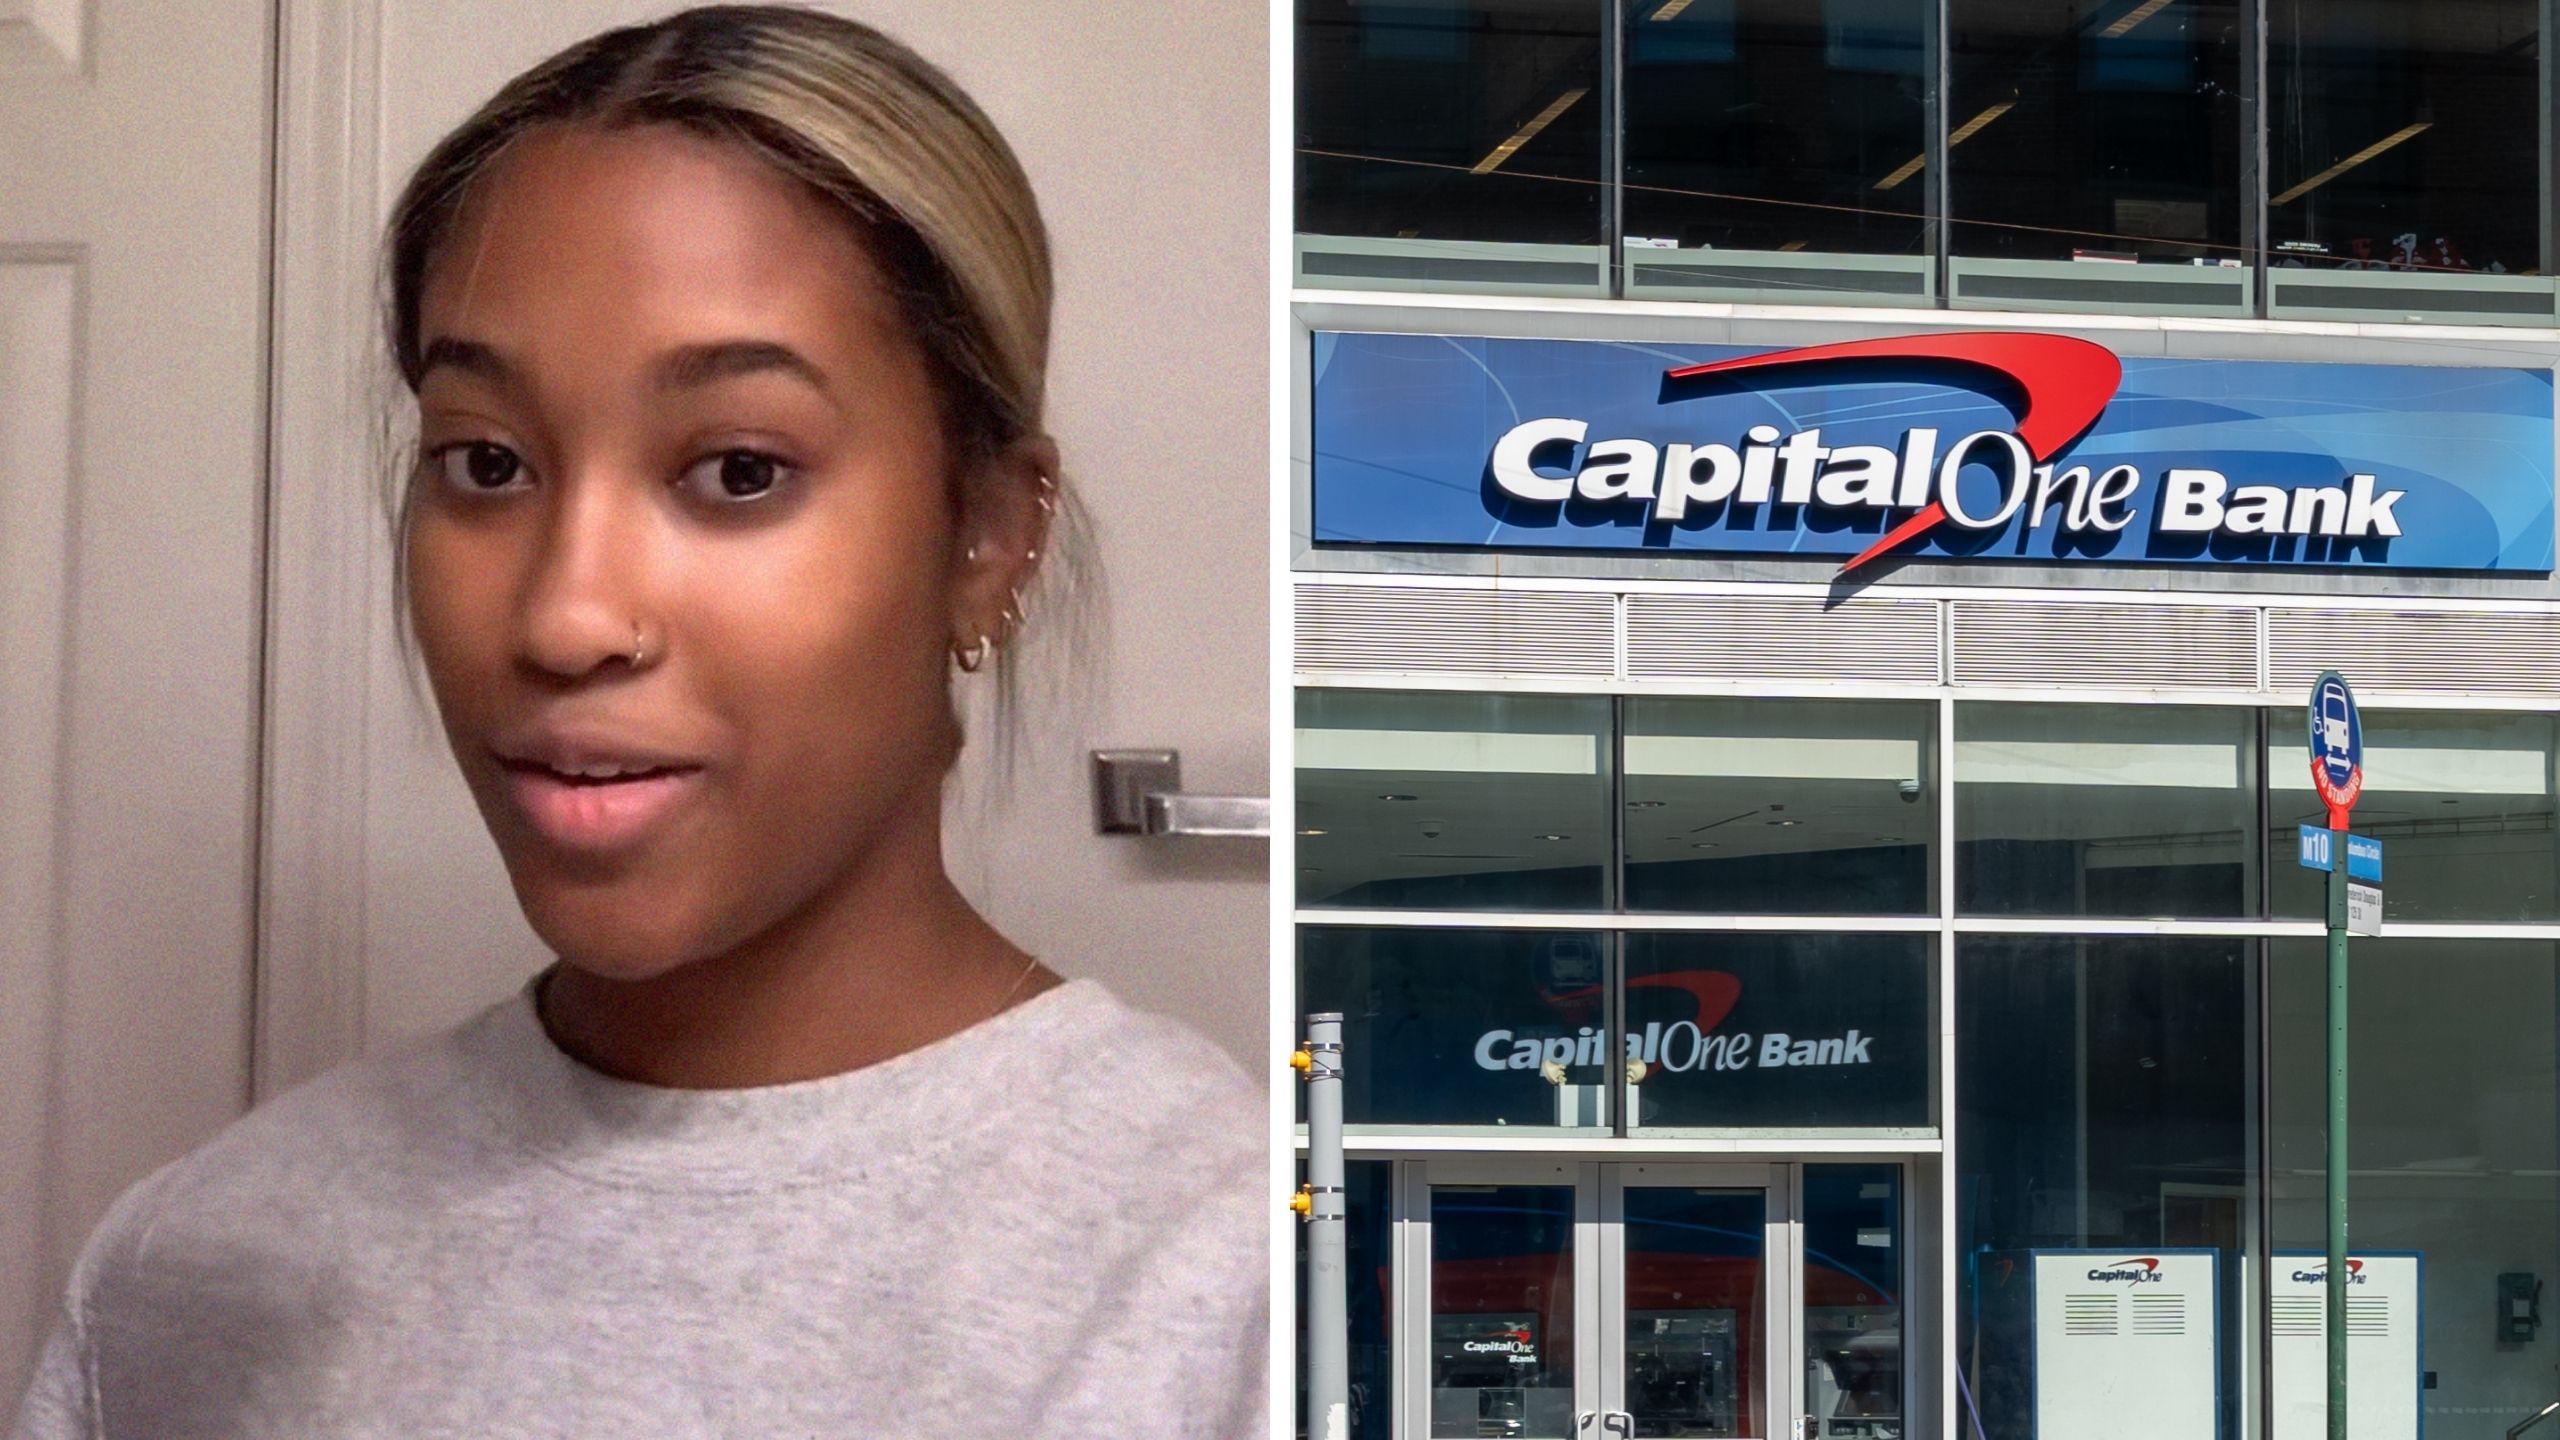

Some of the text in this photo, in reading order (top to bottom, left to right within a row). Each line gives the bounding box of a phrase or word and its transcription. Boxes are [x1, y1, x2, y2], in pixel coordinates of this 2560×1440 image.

[2160, 469, 2407, 537] Bank
[2327, 772, 2360, 805] STANDING
[2303, 833, 2329, 864] M10
[1758, 1029, 1875, 1068] Bank
[1507, 1354, 1537, 1363] Bank
